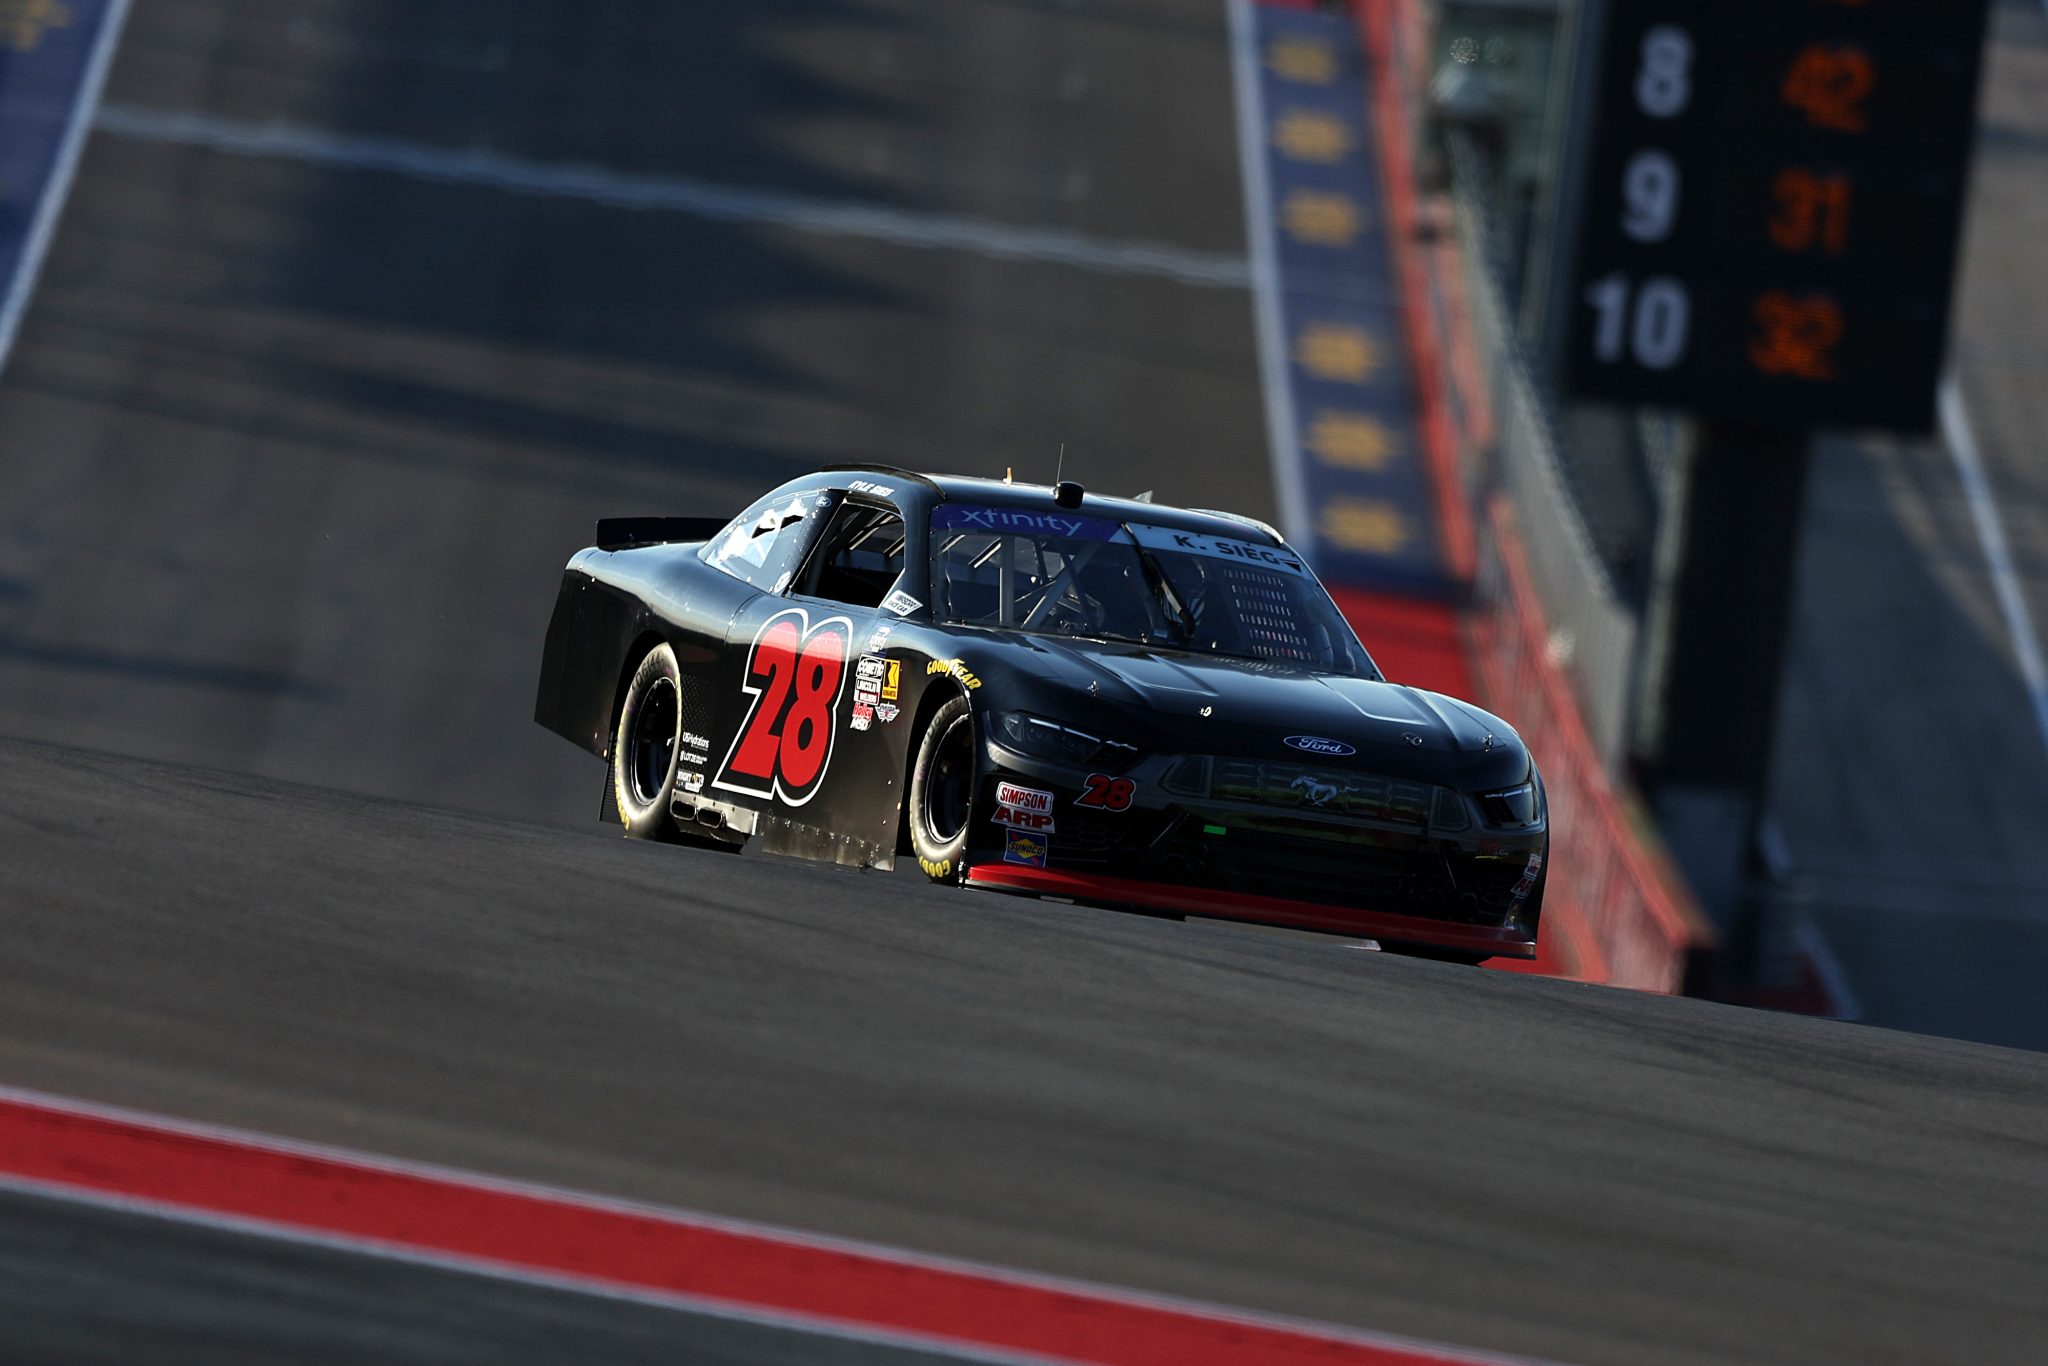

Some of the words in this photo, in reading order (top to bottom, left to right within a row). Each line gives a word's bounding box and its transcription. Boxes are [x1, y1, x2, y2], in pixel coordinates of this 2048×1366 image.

[1635, 24, 1693, 117] 8
[1781, 43, 1875, 133] 42
[1621, 151, 1680, 243] 9
[1769, 167, 1852, 255] 31
[1587, 274, 1691, 370] 10
[1748, 293, 1844, 380] 32
[961, 508, 1083, 537] xfinity
[1172, 534, 1207, 550] K.
[1215, 541, 1281, 566] SIEG
[926, 657, 982, 690] GOODYEAR
[715, 611, 851, 803] 28
[1299, 737, 1343, 754] Ford
[1000, 787, 1048, 811] SIMPSON
[1074, 773, 1136, 812] 28
[994, 806, 1053, 829] ARP
[1008, 841, 1045, 857] SUNOCO
